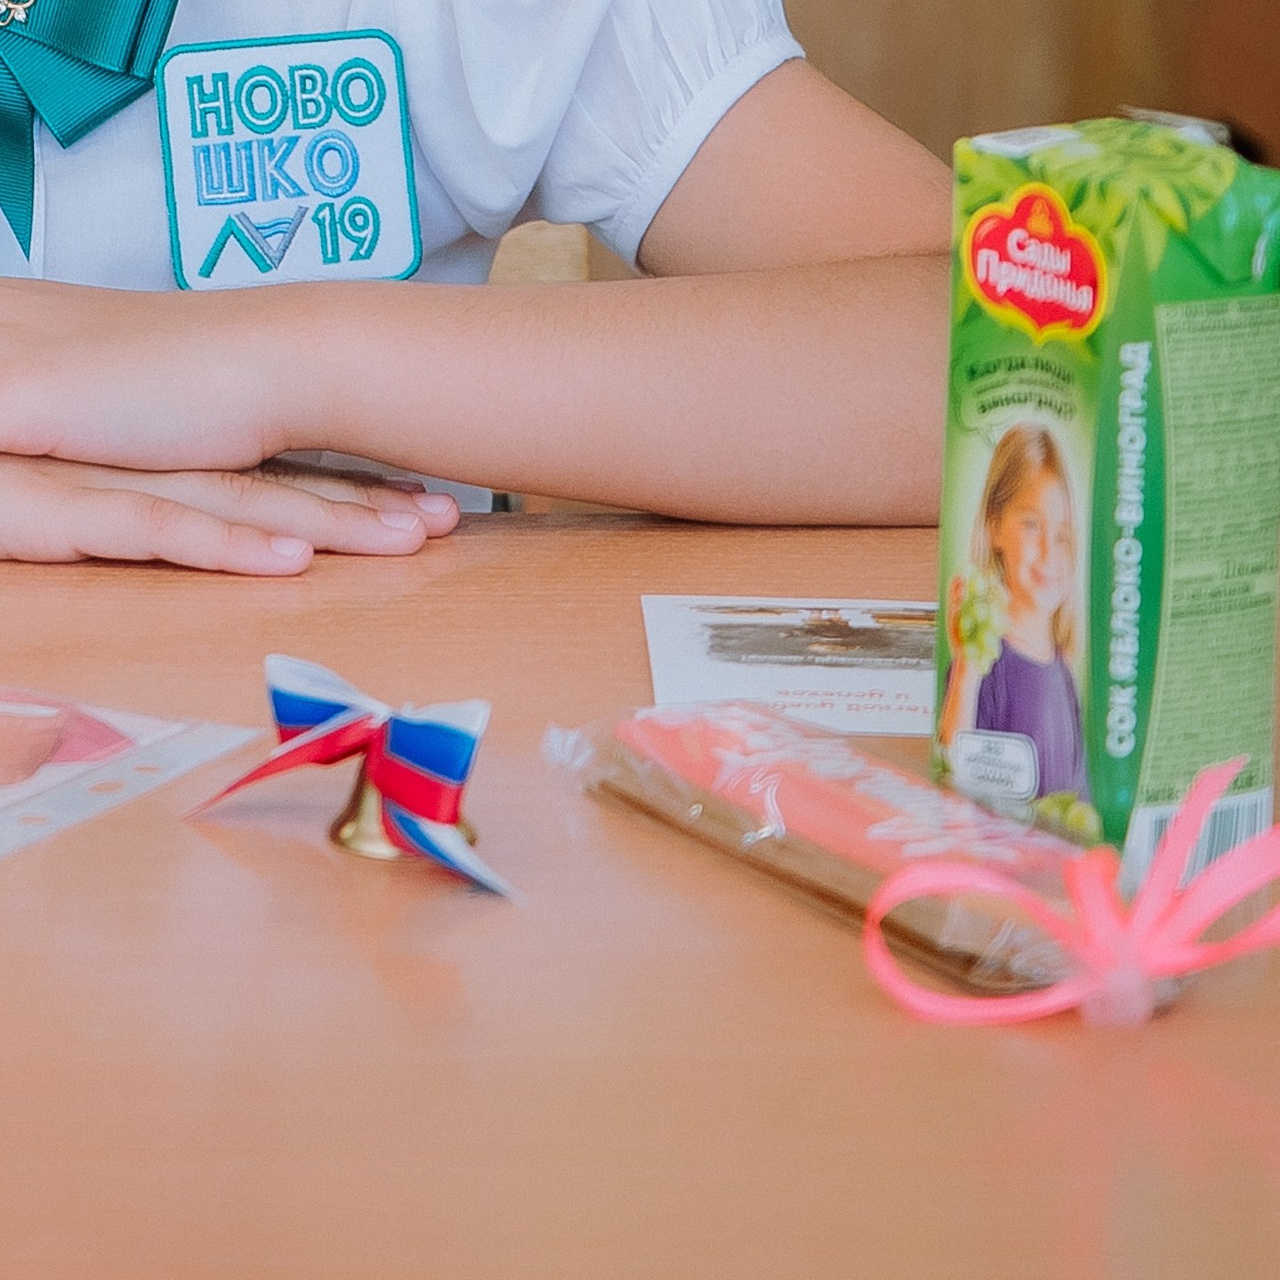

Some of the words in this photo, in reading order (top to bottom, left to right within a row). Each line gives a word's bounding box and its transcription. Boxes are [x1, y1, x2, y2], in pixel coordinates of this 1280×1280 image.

[186, 57, 387, 139] НОВО
[191, 129, 361, 207] ШКО
[976, 248, 1094, 314] Придонья
[1006, 228, 1071, 277] Сады
[1106, 684, 1138, 758] СОК
